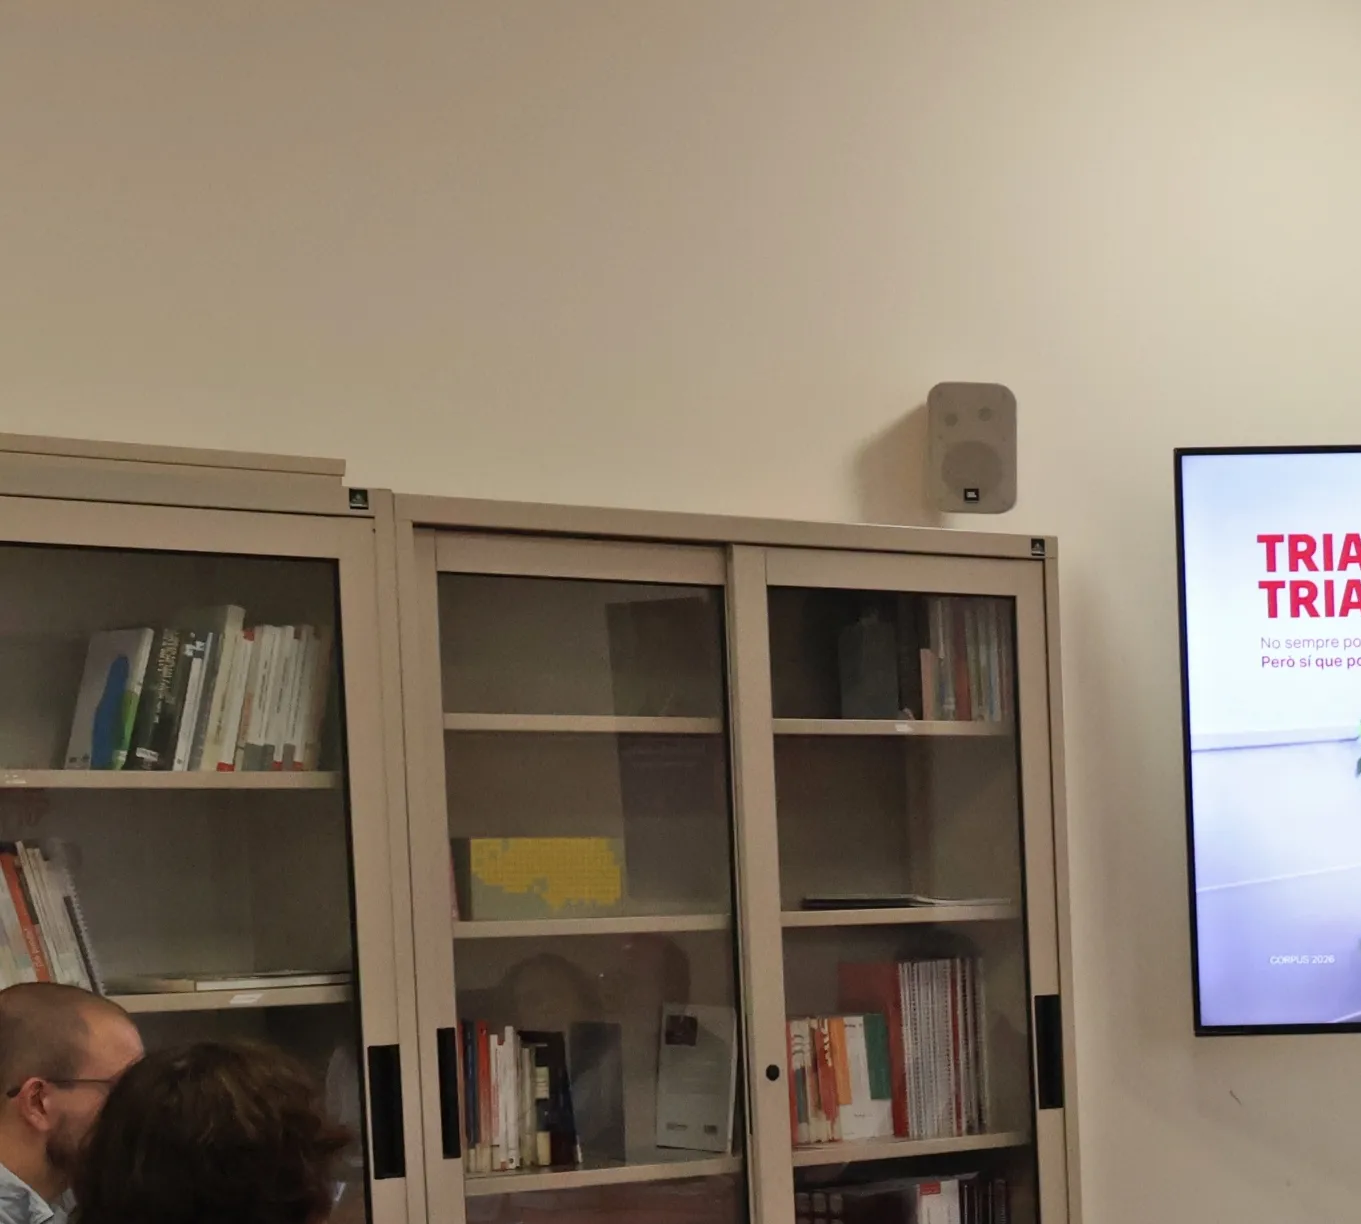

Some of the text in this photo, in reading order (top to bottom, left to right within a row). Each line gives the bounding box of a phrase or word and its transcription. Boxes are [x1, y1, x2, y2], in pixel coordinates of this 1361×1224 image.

[1260, 636, 1281, 650] No
[1284, 637, 1339, 651] sempre
[1261, 655, 1295, 669] Però
[1299, 654, 1312, 668] sí
[1315, 656, 1343, 670] que
[1269, 953, 1336, 966] CORPUS 2026
